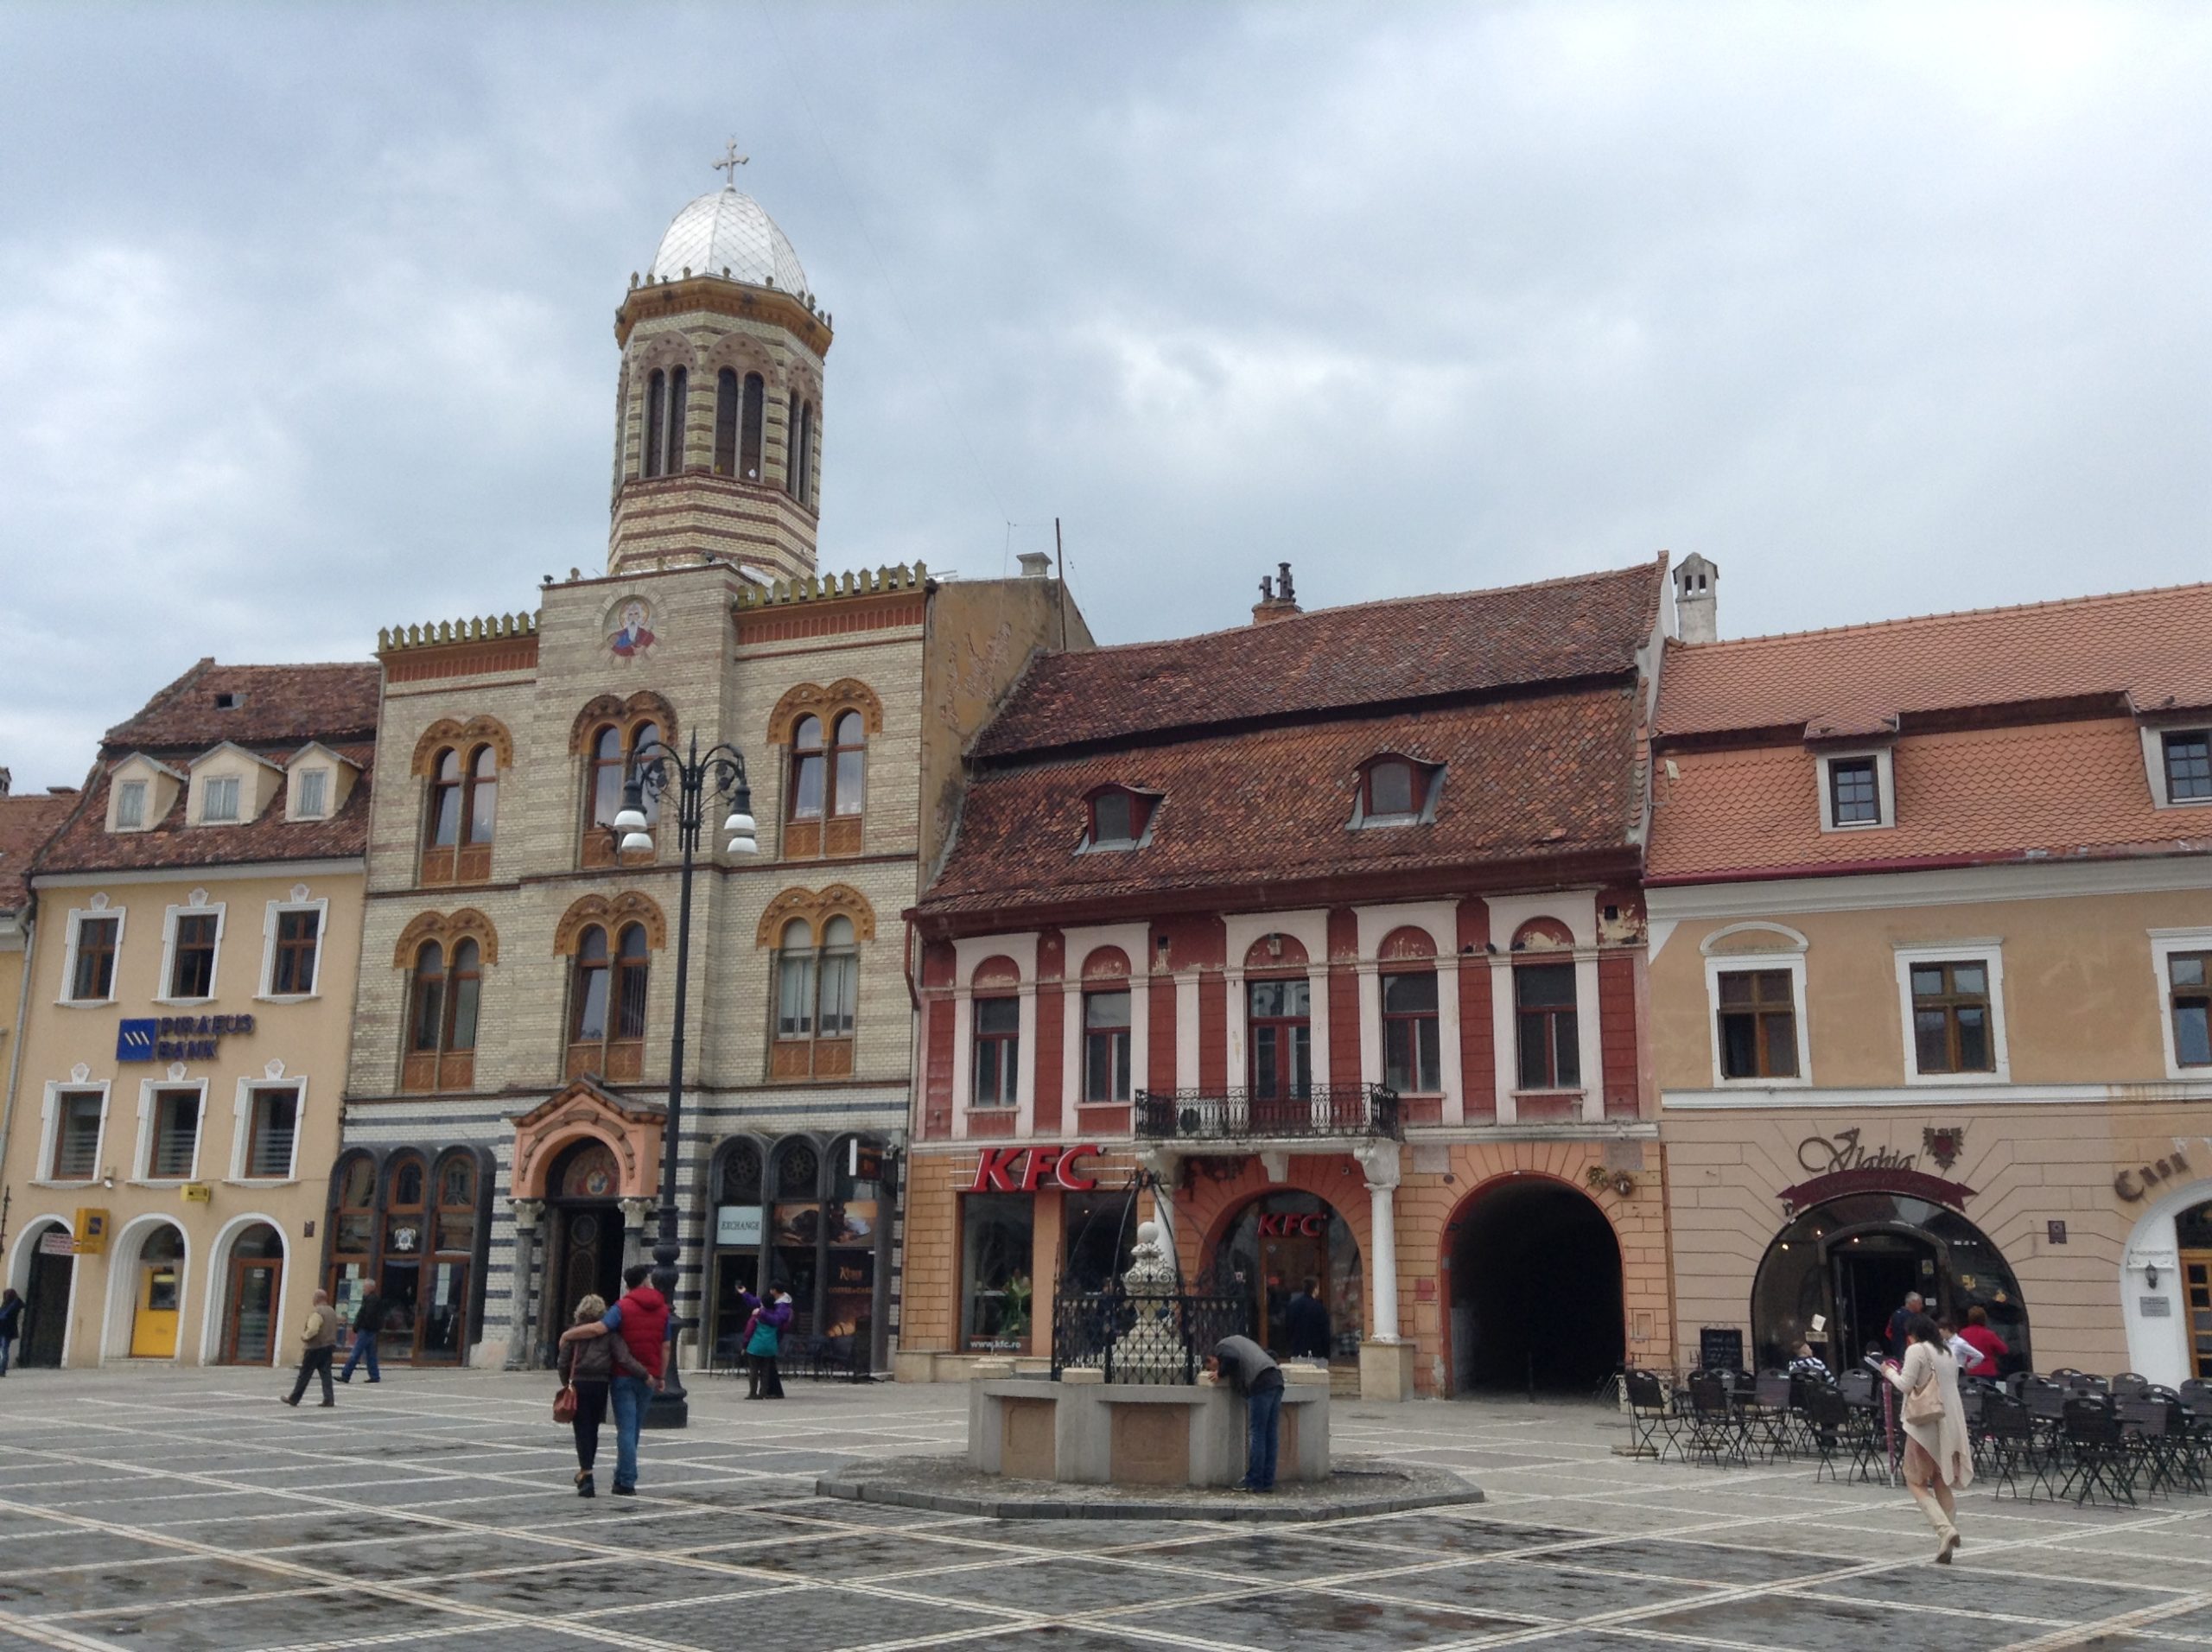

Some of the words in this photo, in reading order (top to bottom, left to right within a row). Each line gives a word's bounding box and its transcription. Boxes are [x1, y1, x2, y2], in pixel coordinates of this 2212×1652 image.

[160, 1014, 254, 1035] PIRAEUS
[157, 1040, 217, 1059] BANK
[968, 1143, 1100, 1191] KFC
[721, 1221, 760, 1230] EXCHANGE
[1257, 1211, 1322, 1239] KFC
[969, 1340, 1021, 1349] www.kfc.ro
